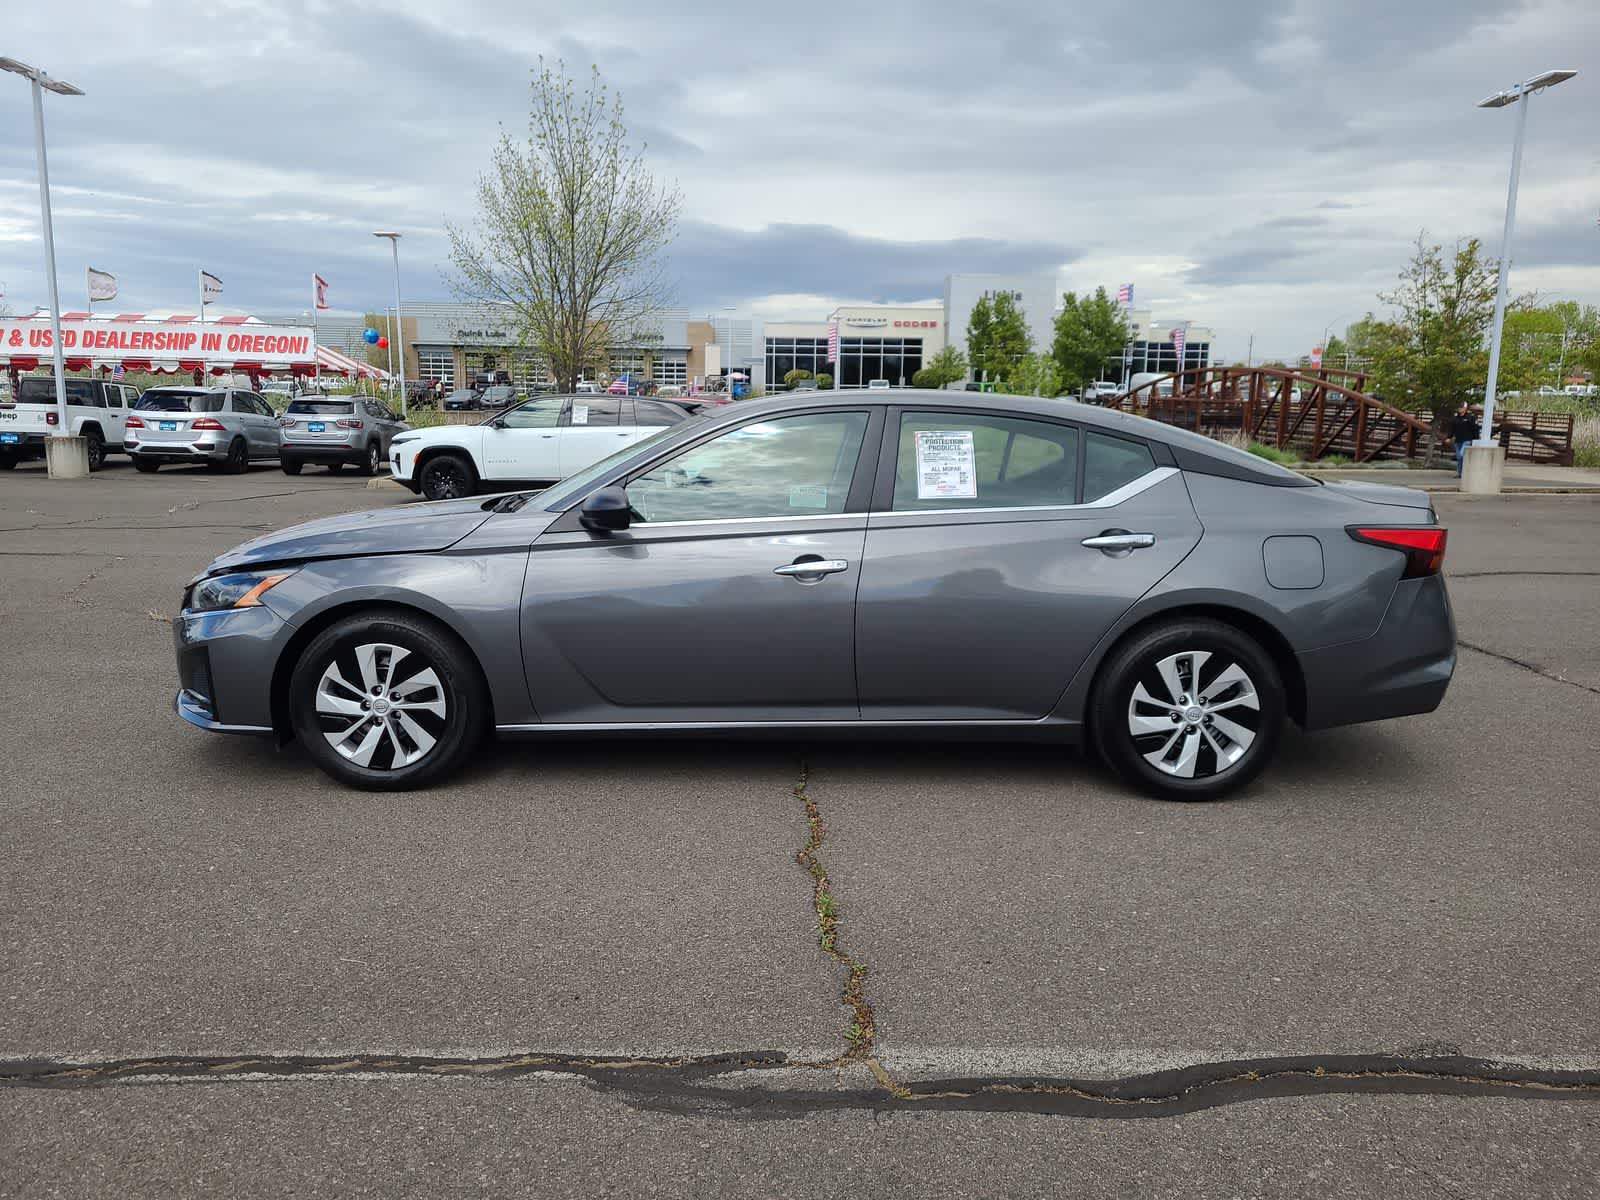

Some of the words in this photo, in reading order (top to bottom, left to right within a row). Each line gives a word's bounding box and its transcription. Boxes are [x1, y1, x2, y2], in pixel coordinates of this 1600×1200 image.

[894, 320, 937, 328] DODGE
[8, 328, 24, 347] &
[82, 330, 197, 351] DEALERSHIP
[200, 333, 222, 352] IN
[227, 334, 309, 354] OREGON!
